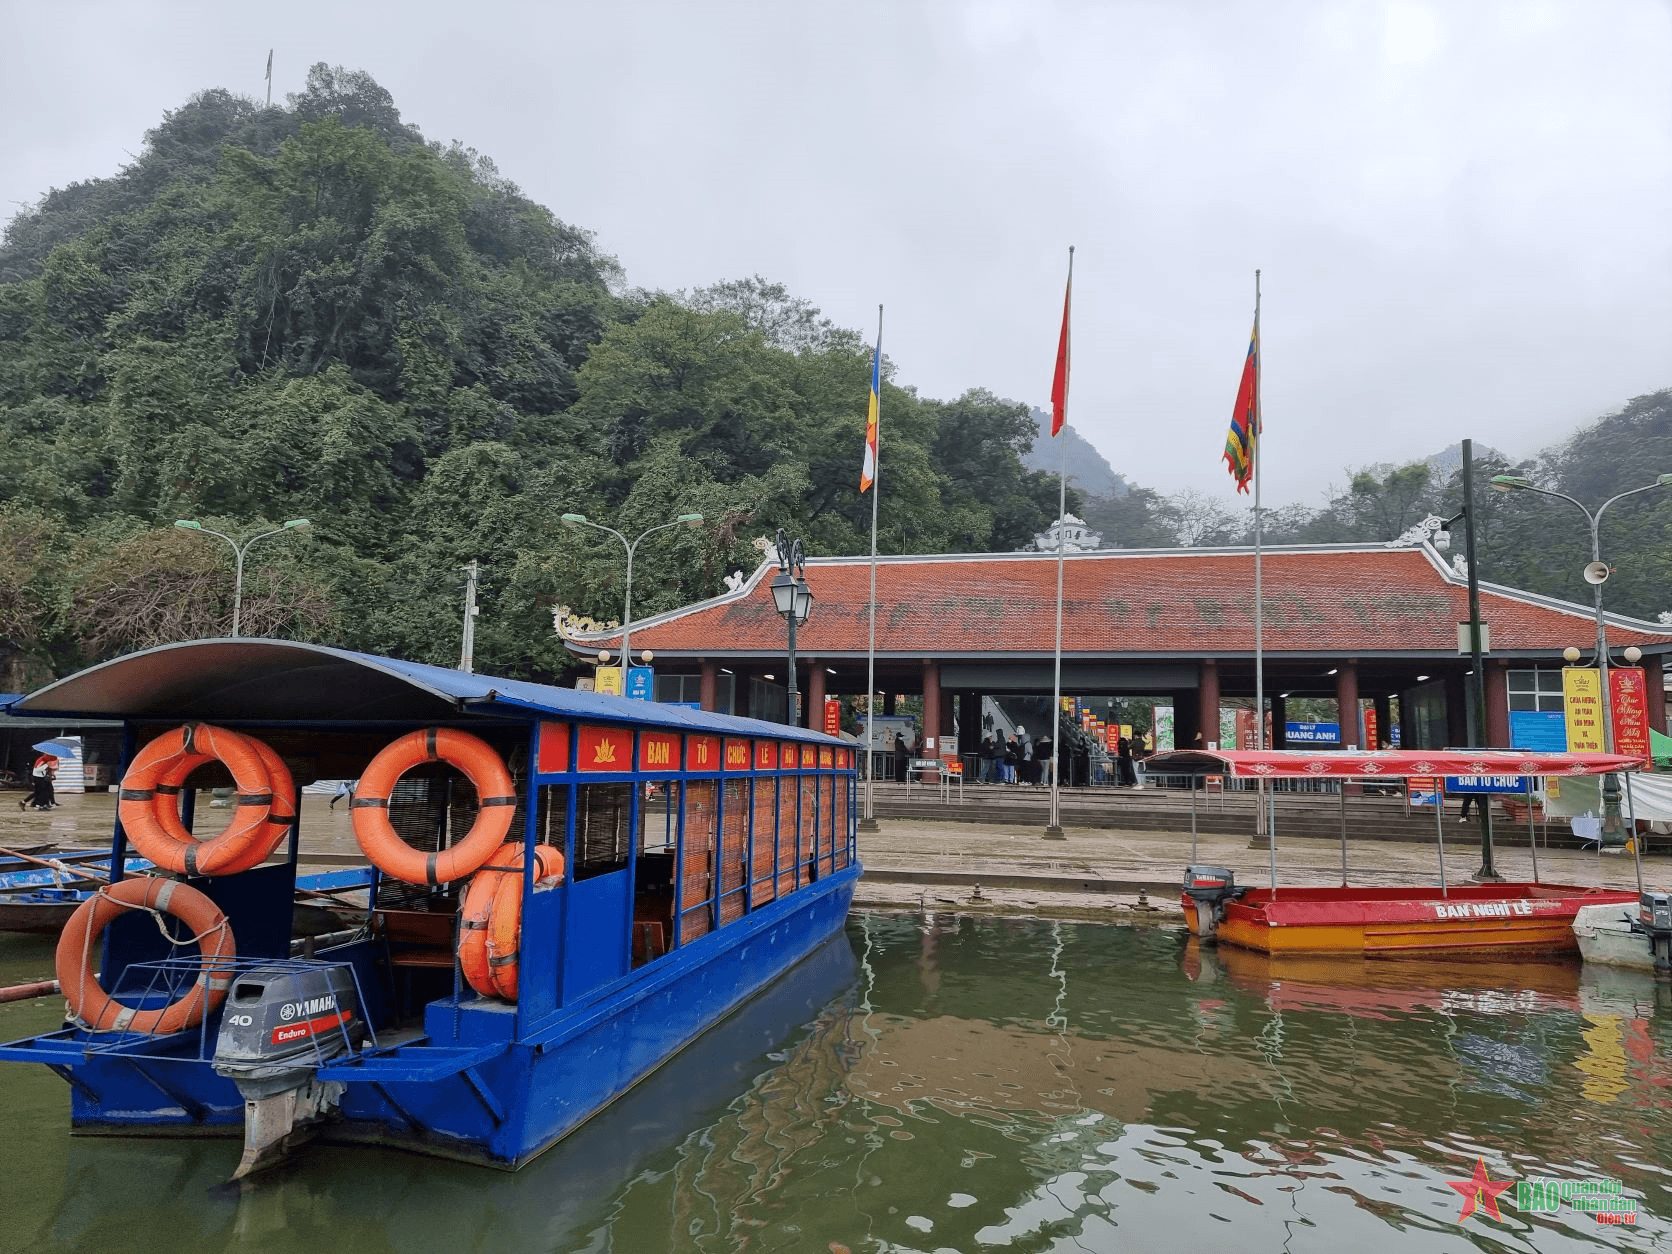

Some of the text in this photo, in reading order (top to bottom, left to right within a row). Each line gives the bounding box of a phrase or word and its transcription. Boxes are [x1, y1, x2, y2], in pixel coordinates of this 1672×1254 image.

[1315, 732, 1336, 740] ANH
[647, 741, 670, 764] BAN
[697, 737, 708, 764] TỔ
[1436, 904, 1470, 918] BAN
[228, 1015, 253, 1026] 40
[278, 1029, 306, 1040] Enduro
